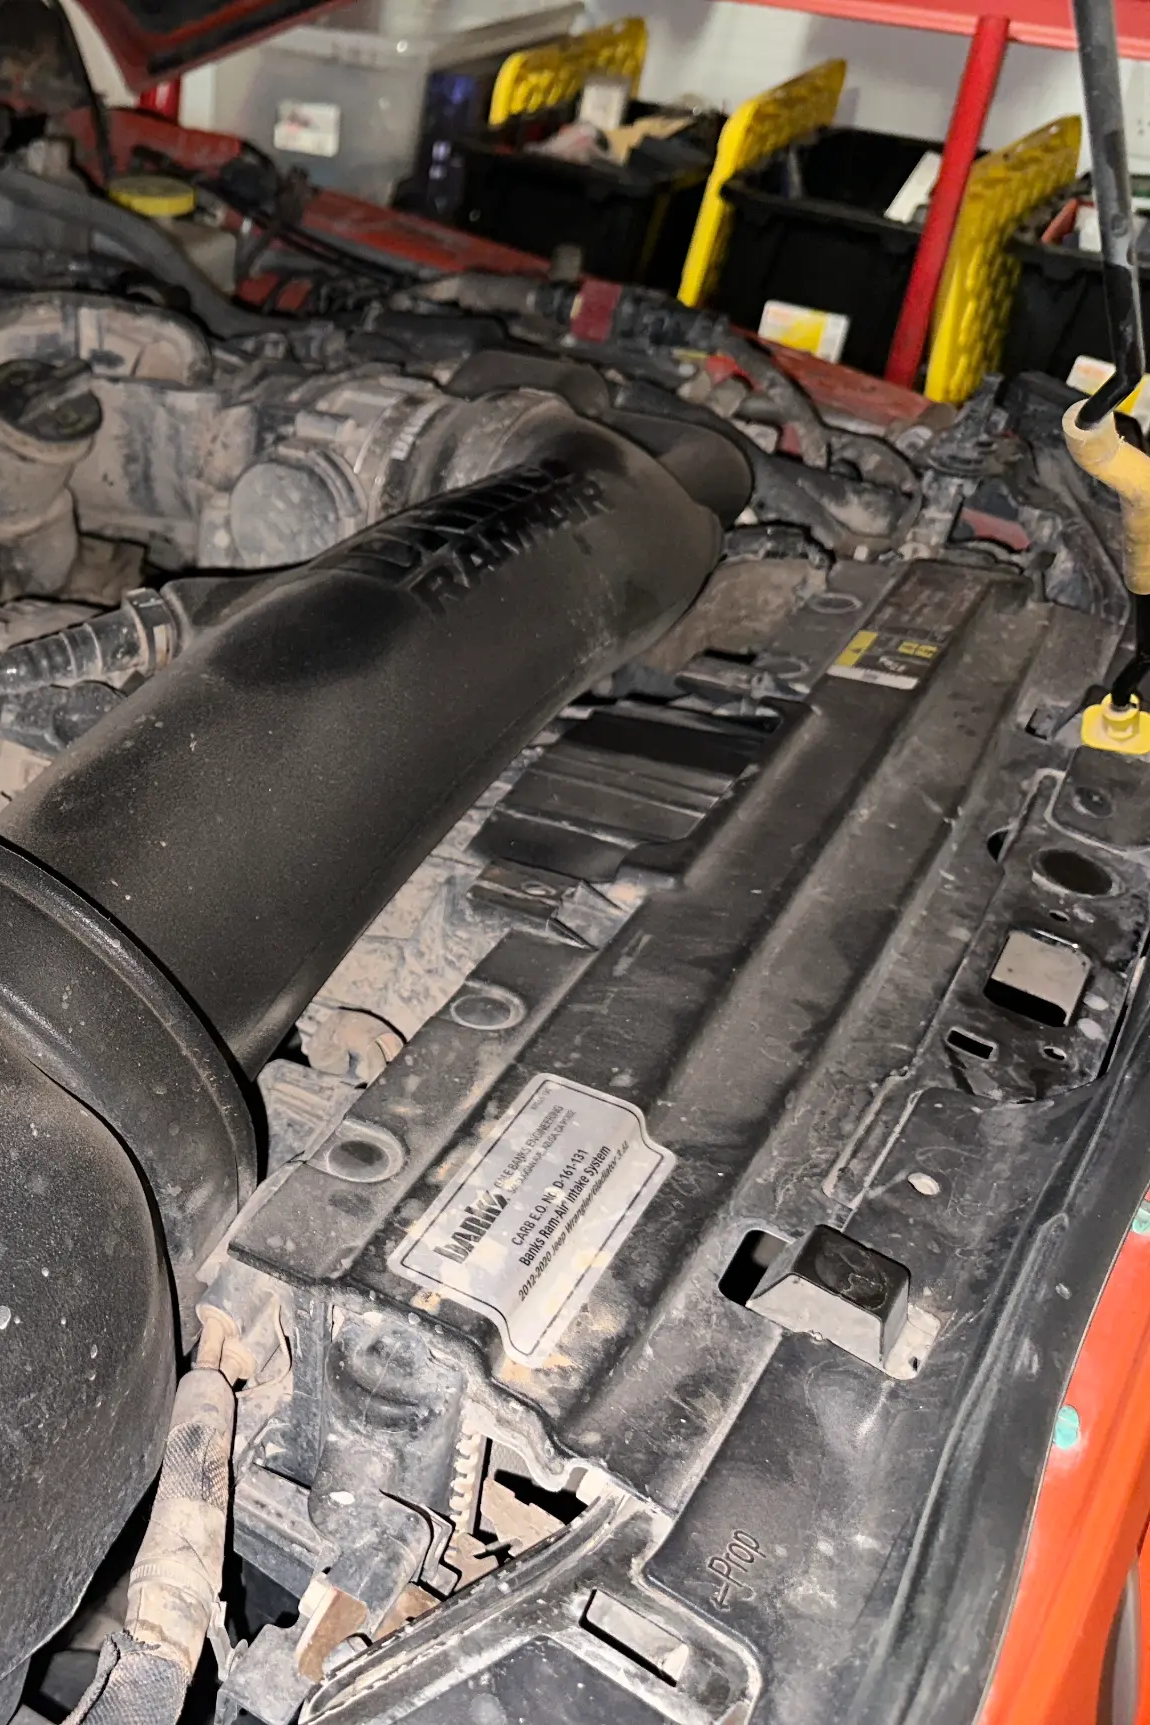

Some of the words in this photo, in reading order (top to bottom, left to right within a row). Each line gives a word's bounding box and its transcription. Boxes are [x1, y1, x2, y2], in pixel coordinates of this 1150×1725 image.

[509, 1217, 536, 1247] CARB
[528, 1200, 549, 1222] E.O.
[554, 1147, 588, 1189] D-161-131
[517, 1234, 547, 1267] Banks
[563, 1172, 590, 1204] Intake
[583, 1143, 612, 1178] System
[517, 1252, 553, 1300] 2012-2020
[707, 1529, 767, 1586] Prop
